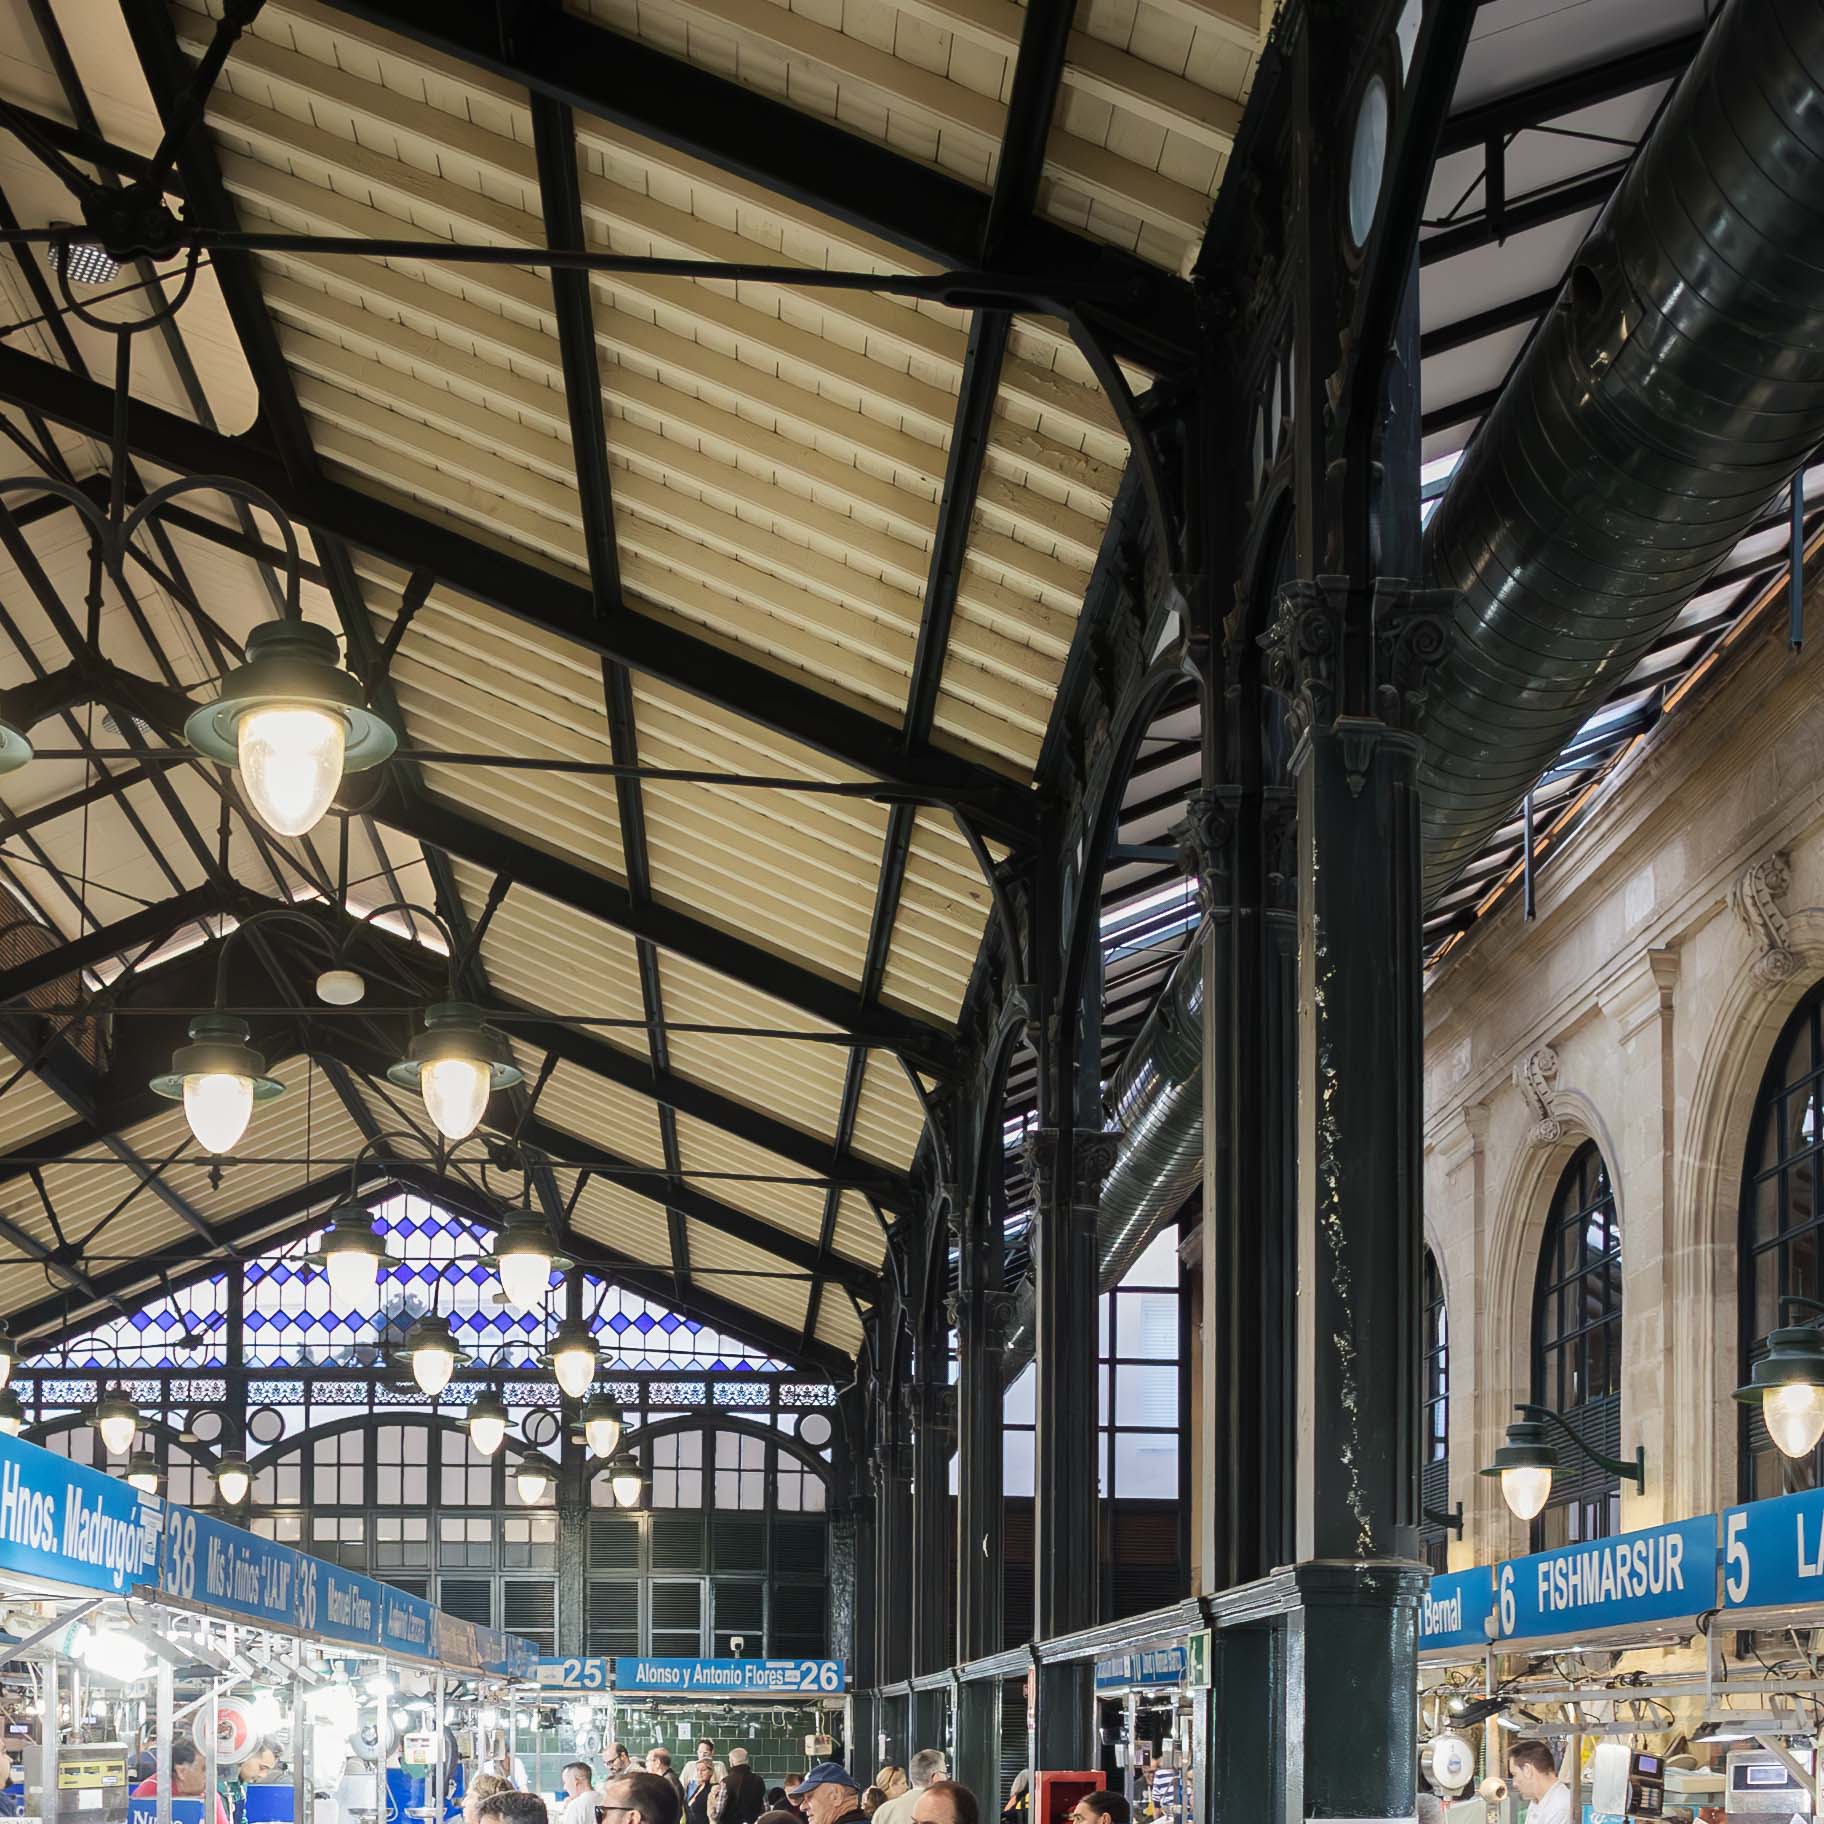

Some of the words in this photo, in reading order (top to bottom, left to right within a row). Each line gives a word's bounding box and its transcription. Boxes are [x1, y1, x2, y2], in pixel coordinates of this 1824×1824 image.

[0, 1460, 58, 1554] Hnos.
[63, 1484, 145, 1589] Madrugón
[167, 1512, 196, 1600] 38
[1726, 1512, 1750, 1604] 5
[300, 1559, 318, 1630] 36
[1424, 1587, 1462, 1636] Bernal
[1499, 1565, 1517, 1637] 6
[1538, 1534, 1685, 1613] FISHMARSUR
[563, 1659, 602, 1688] 25
[636, 1662, 680, 1684] Alonso
[682, 1668, 691, 1689] y
[693, 1664, 743, 1685] Antonio
[745, 1664, 784, 1685] Flores
[799, 1661, 839, 1691] 26
